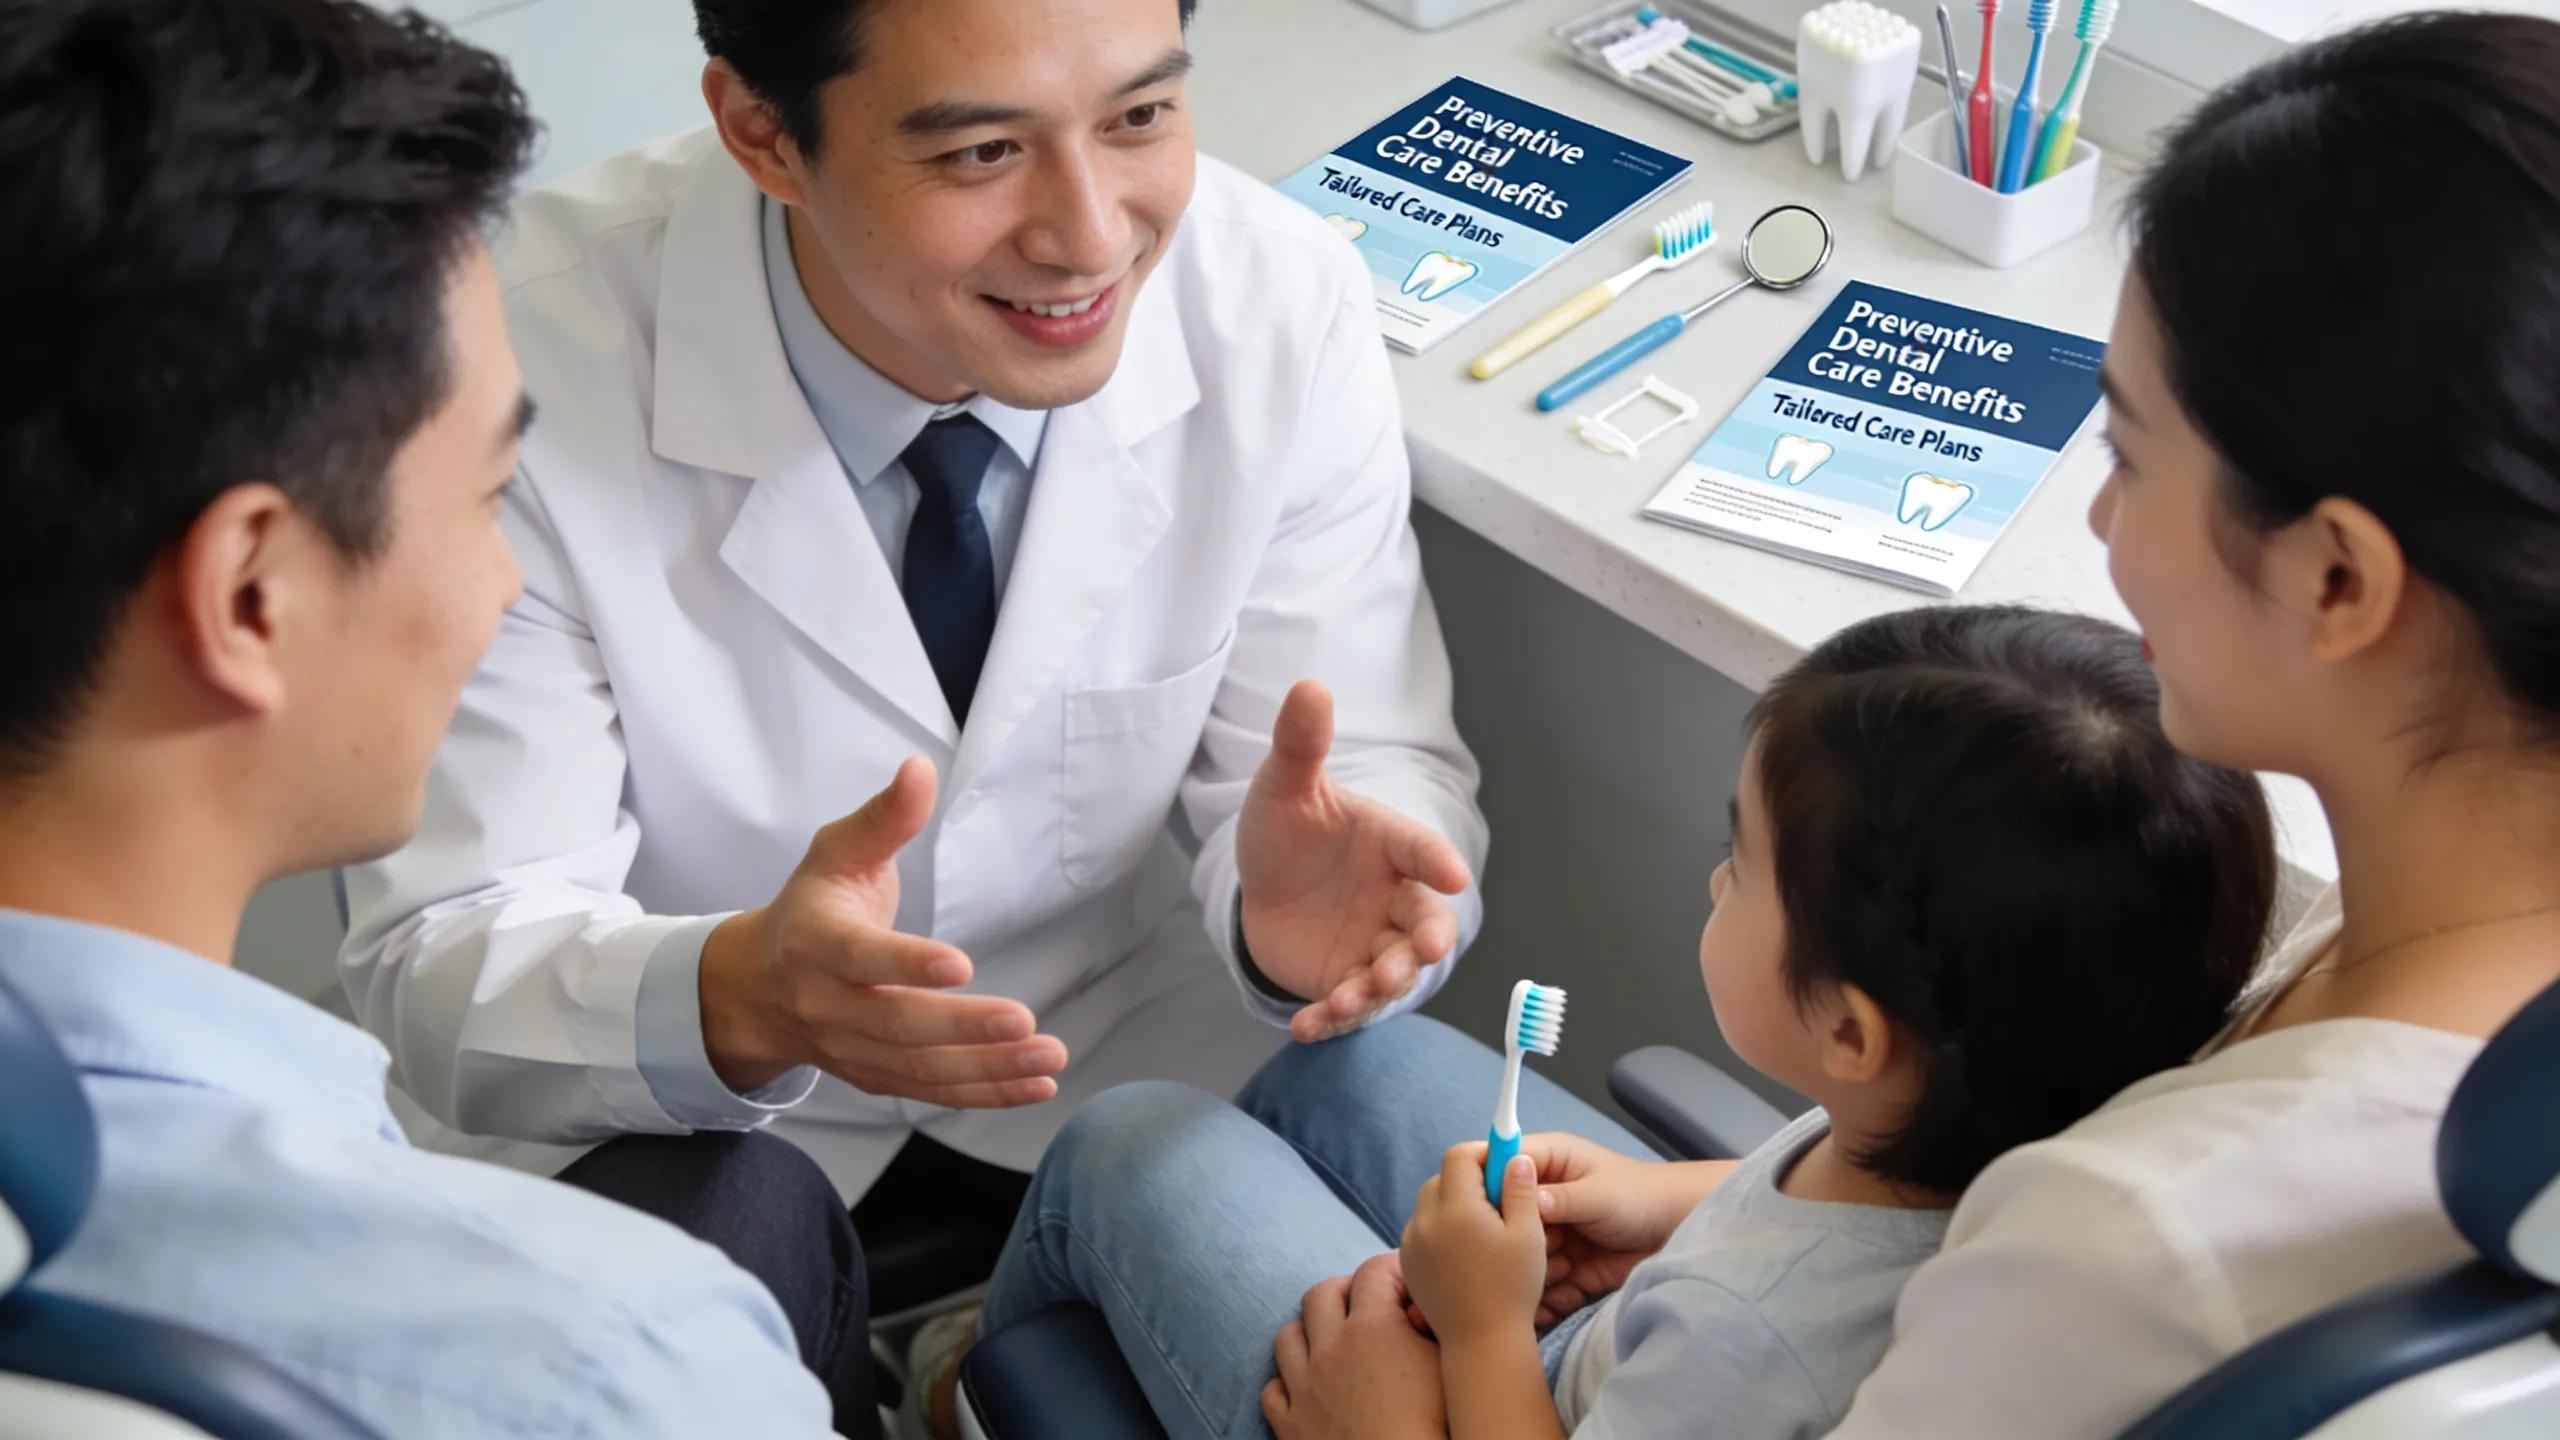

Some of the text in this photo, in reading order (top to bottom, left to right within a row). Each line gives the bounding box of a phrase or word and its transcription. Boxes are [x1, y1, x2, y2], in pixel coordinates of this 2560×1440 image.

[1407, 116, 1516, 167] Dental
[1435, 96, 1584, 164] Preventive
[1376, 135, 1443, 174] Care
[1444, 160, 1569, 219] Benefits
[1400, 198, 1446, 226] Care
[1445, 213, 1504, 247] Plans
[1828, 326, 1946, 374] Dental
[1845, 300, 2013, 362] Preventive
[1808, 352, 2026, 423] Care Benefits
[1865, 417, 1915, 445] Care
[1919, 430, 1983, 462] Plans
